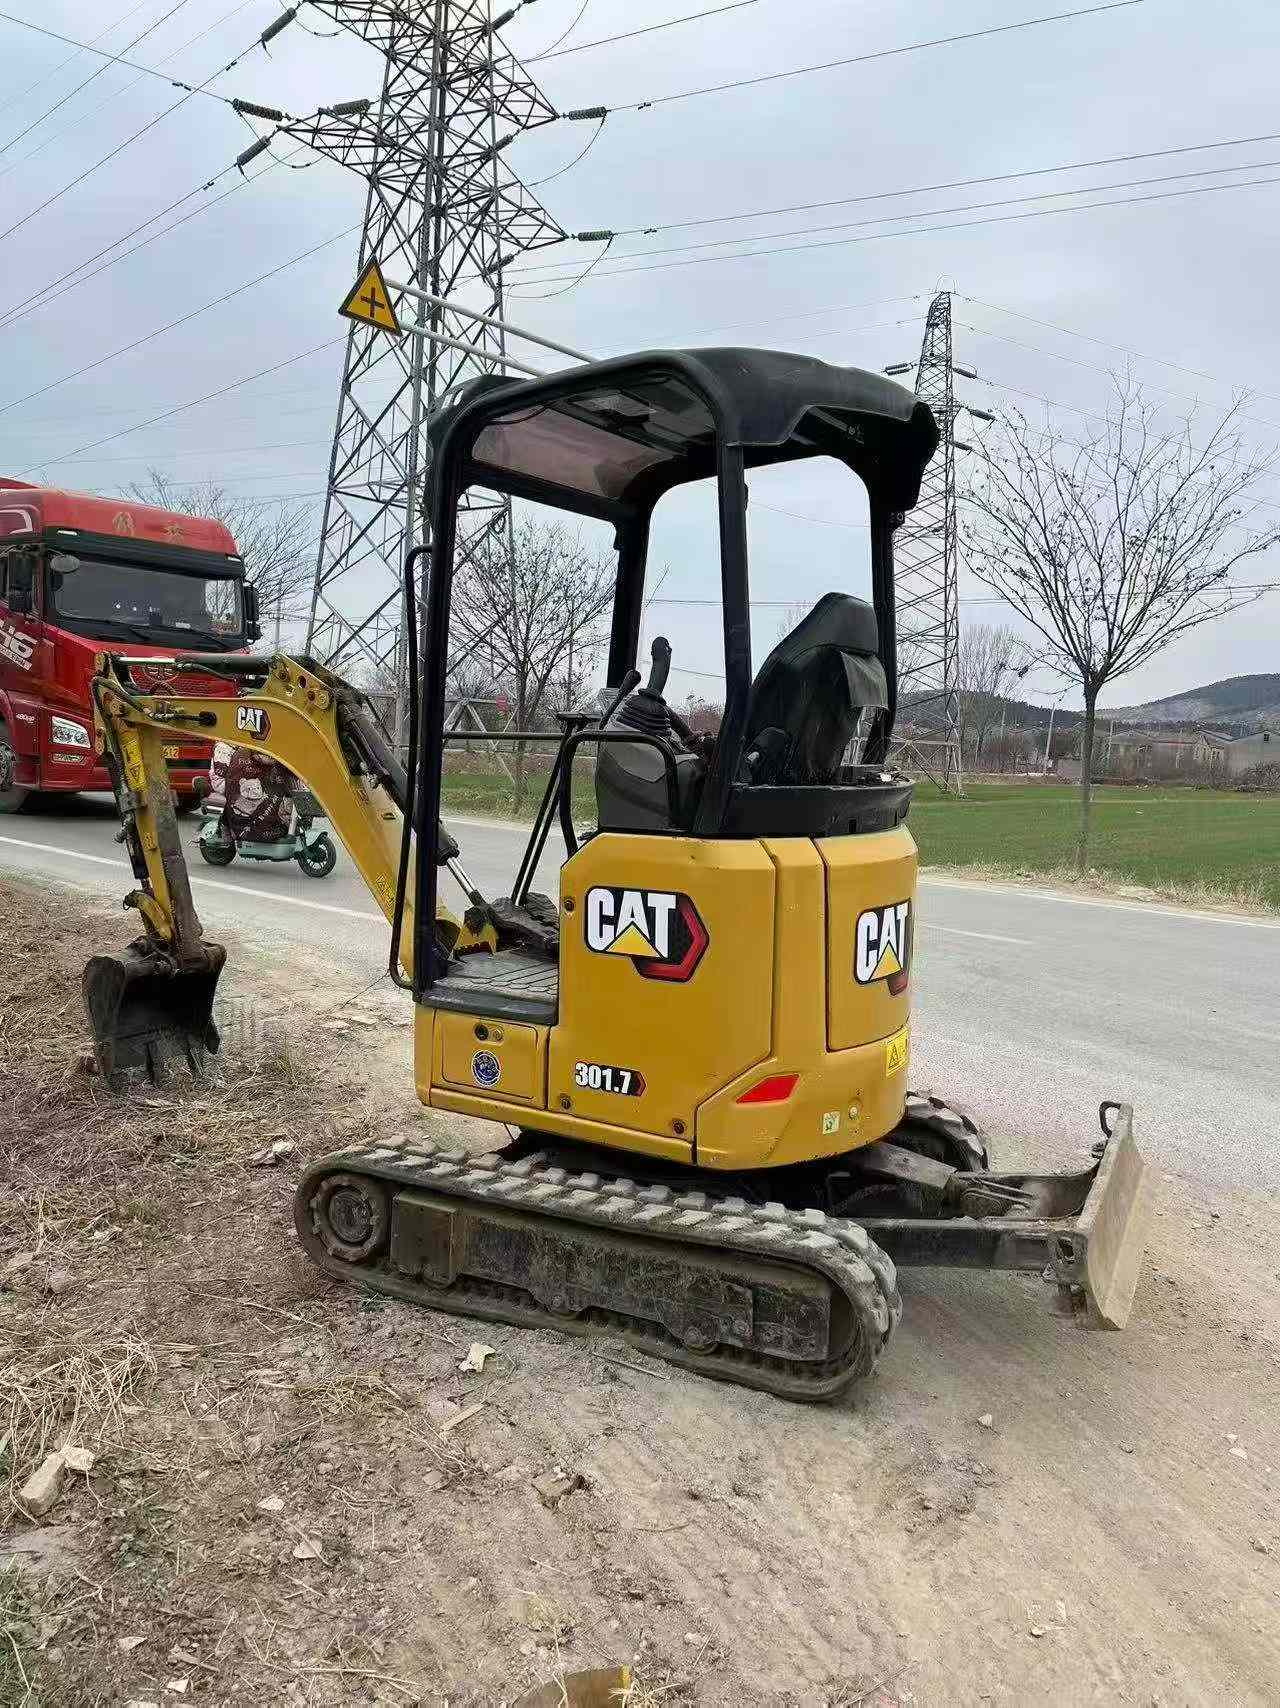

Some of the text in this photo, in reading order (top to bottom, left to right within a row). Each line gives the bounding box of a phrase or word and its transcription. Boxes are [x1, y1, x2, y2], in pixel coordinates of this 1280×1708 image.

[237, 706, 263, 732] CAT
[587, 888, 677, 959] CAT
[857, 901, 909, 981] CAT
[575, 1062, 631, 1093] 301.7
